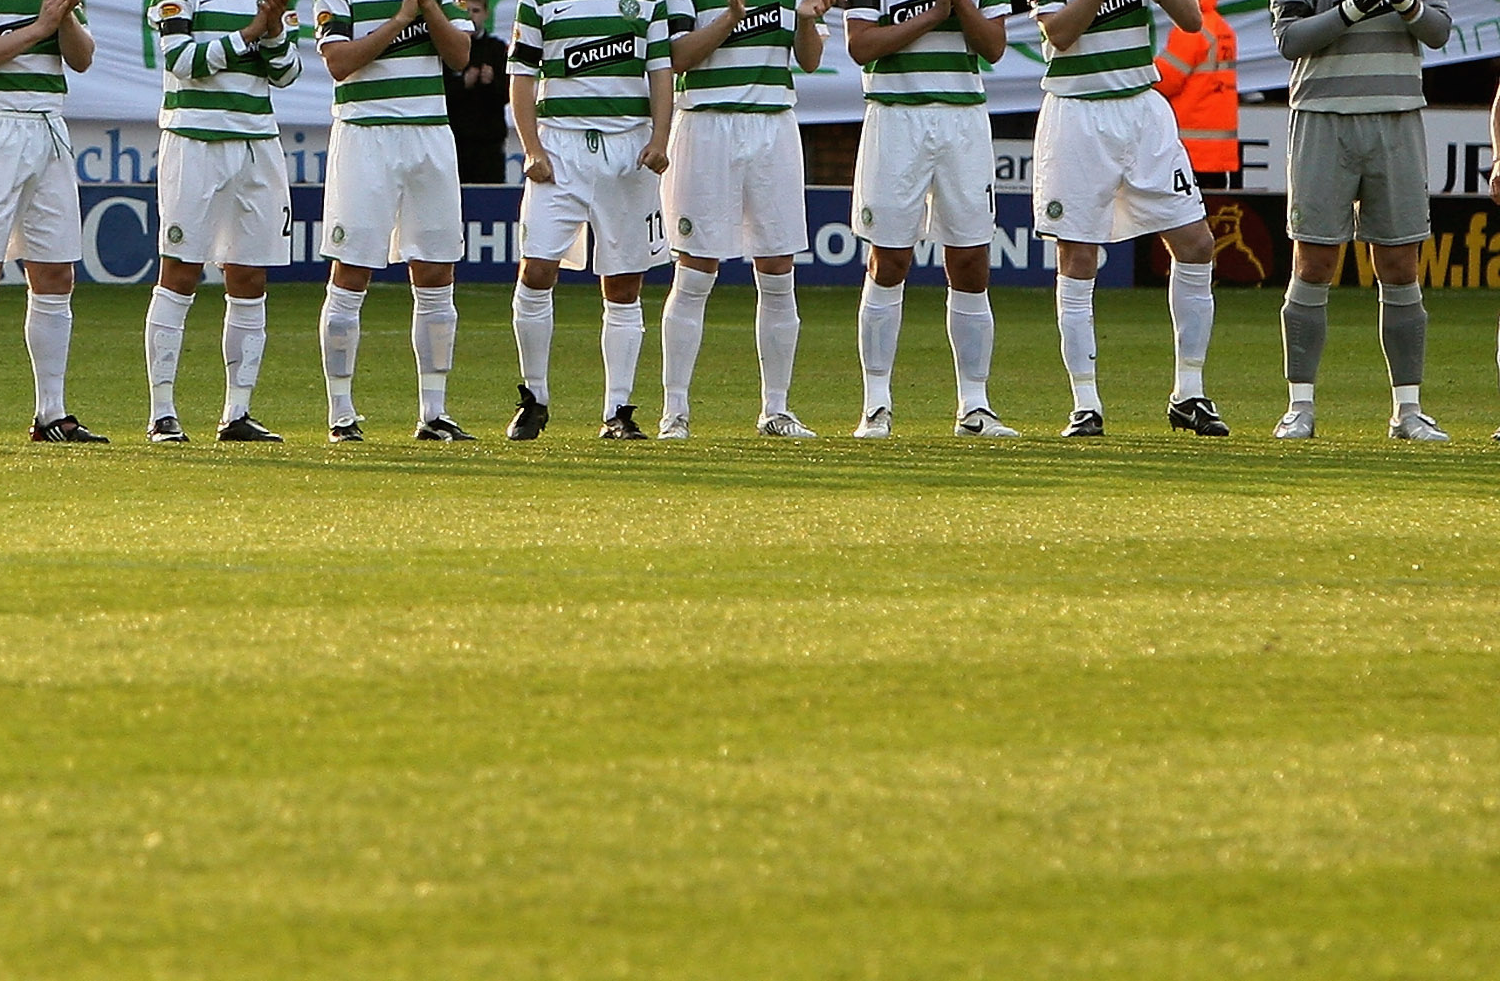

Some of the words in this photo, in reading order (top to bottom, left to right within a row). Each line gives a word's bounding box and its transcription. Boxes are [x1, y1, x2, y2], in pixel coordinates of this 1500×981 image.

[733, 9, 779, 33] RLING
[567, 39, 633, 69] CARLING
[645, 210, 664, 243] 11
